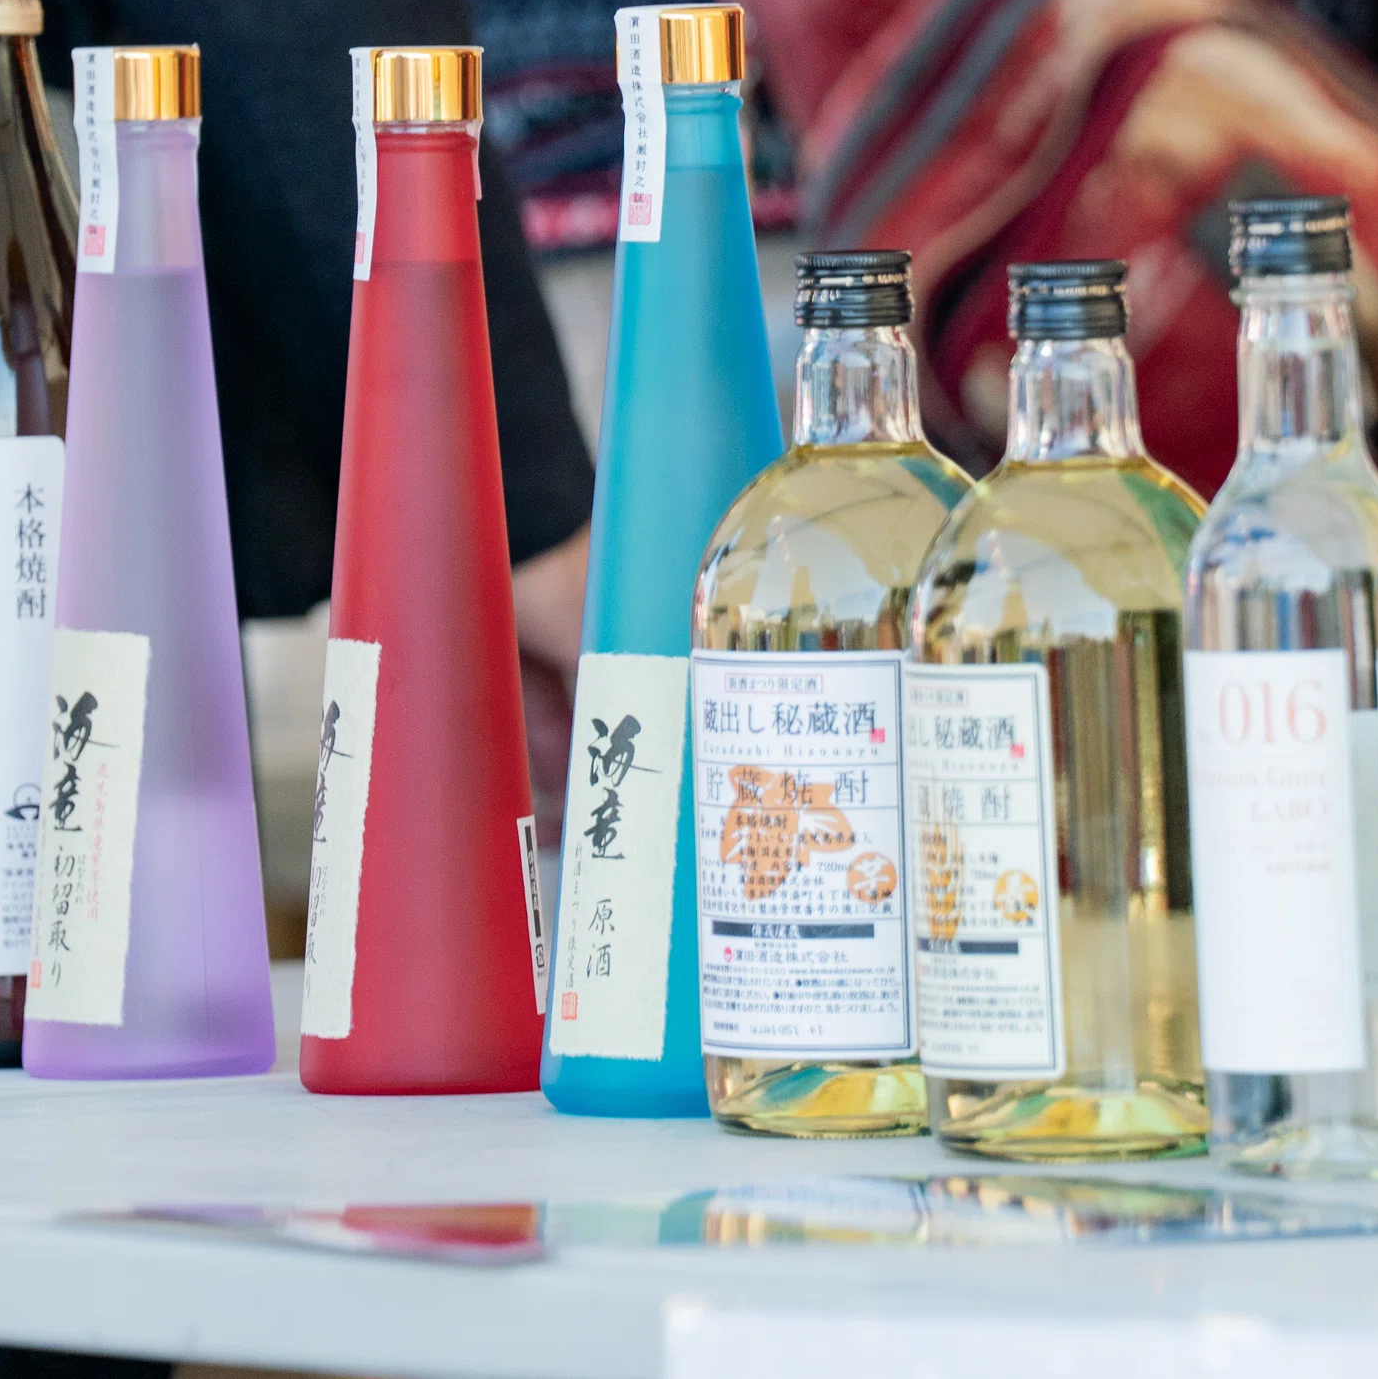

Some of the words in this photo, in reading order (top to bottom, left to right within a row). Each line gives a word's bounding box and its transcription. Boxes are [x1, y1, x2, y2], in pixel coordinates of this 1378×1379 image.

[15, 482, 47, 620] 本格焼酎
[702, 699, 877, 736] 蔵出し秘蔵酒
[728, 677, 818, 692] 新酒まつり限定酒
[1219, 679, 1327, 747] 016
[706, 767, 870, 805] 貯蔵焼酎
[46, 845, 76, 988] 初留取り
[585, 898, 616, 979] 原酒
